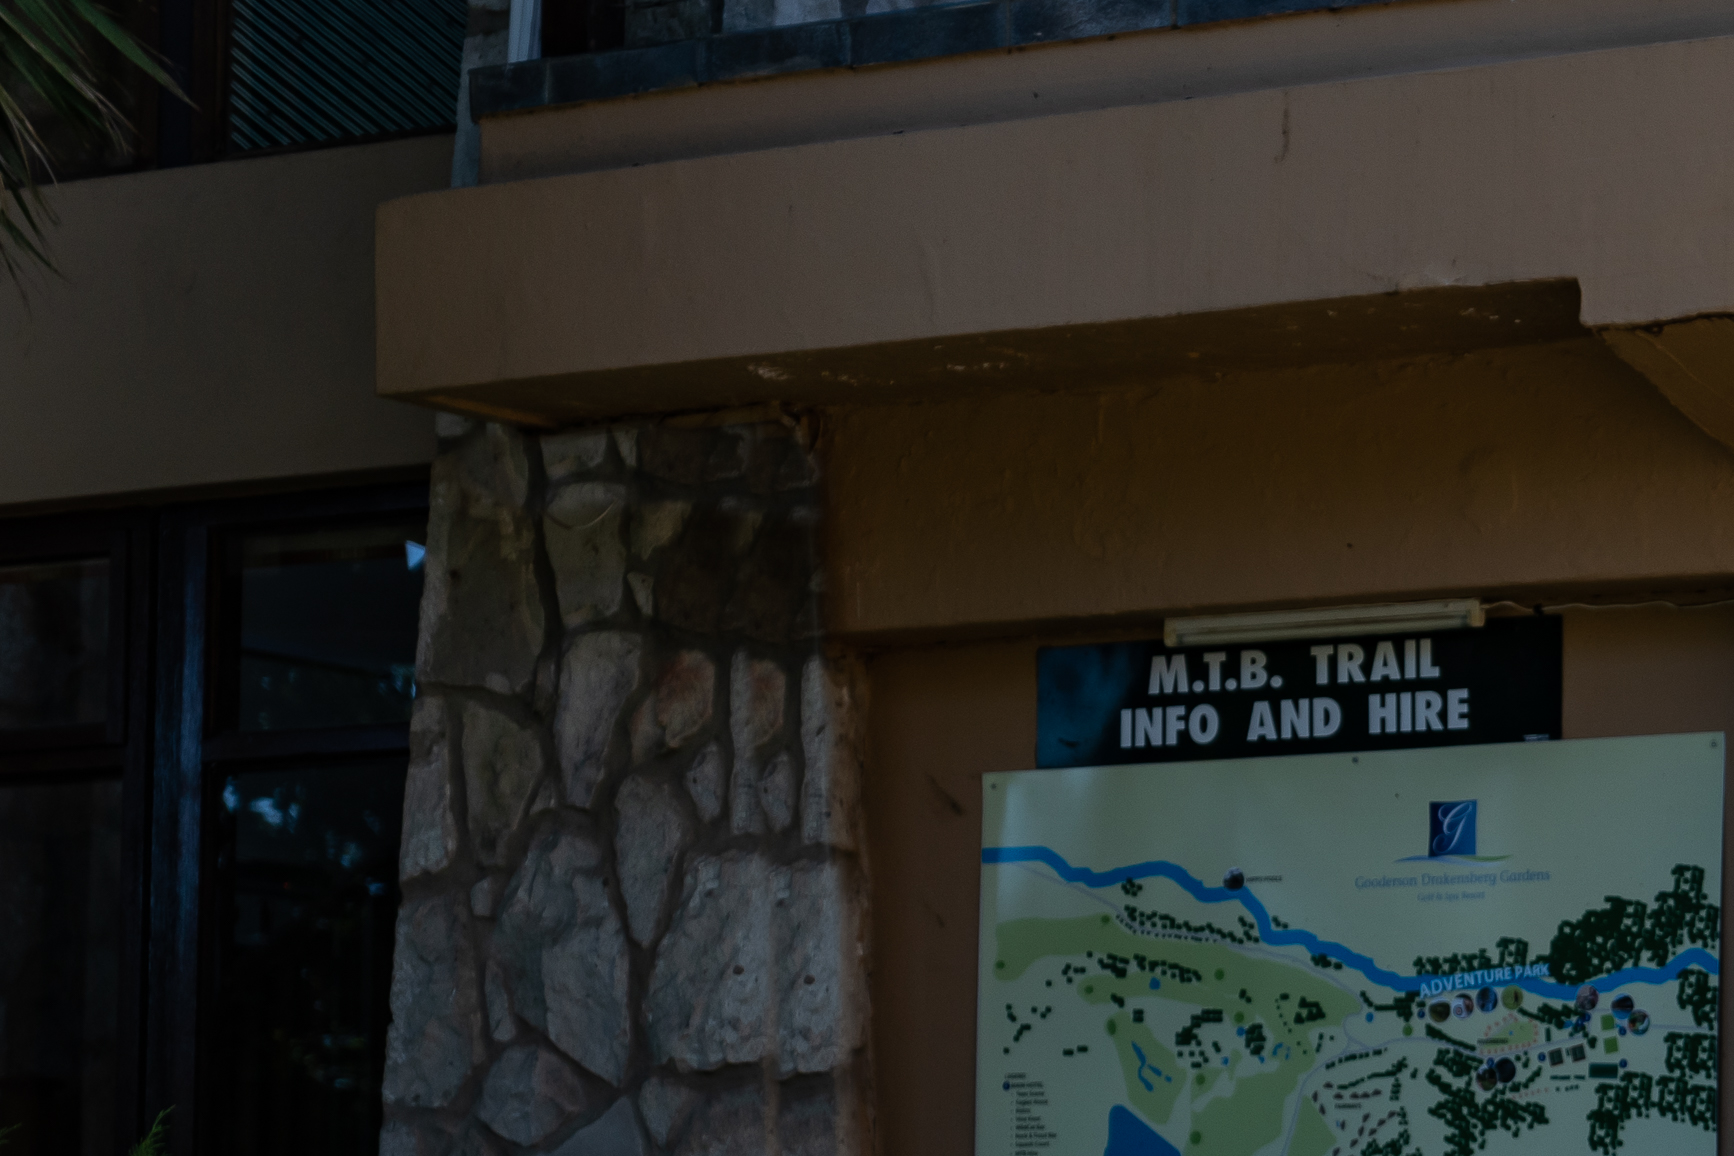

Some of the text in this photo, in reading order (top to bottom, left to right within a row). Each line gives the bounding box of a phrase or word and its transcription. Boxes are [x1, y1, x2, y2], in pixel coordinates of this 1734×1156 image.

[1148, 639, 1440, 695] M.T.B. TRAIL
[1120, 688, 1470, 749] INFO AND HIRE
[1355, 869, 1550, 889] Gooderson Drakensberg Gardens
[1419, 962, 1550, 999] ADVENTURE PARK
